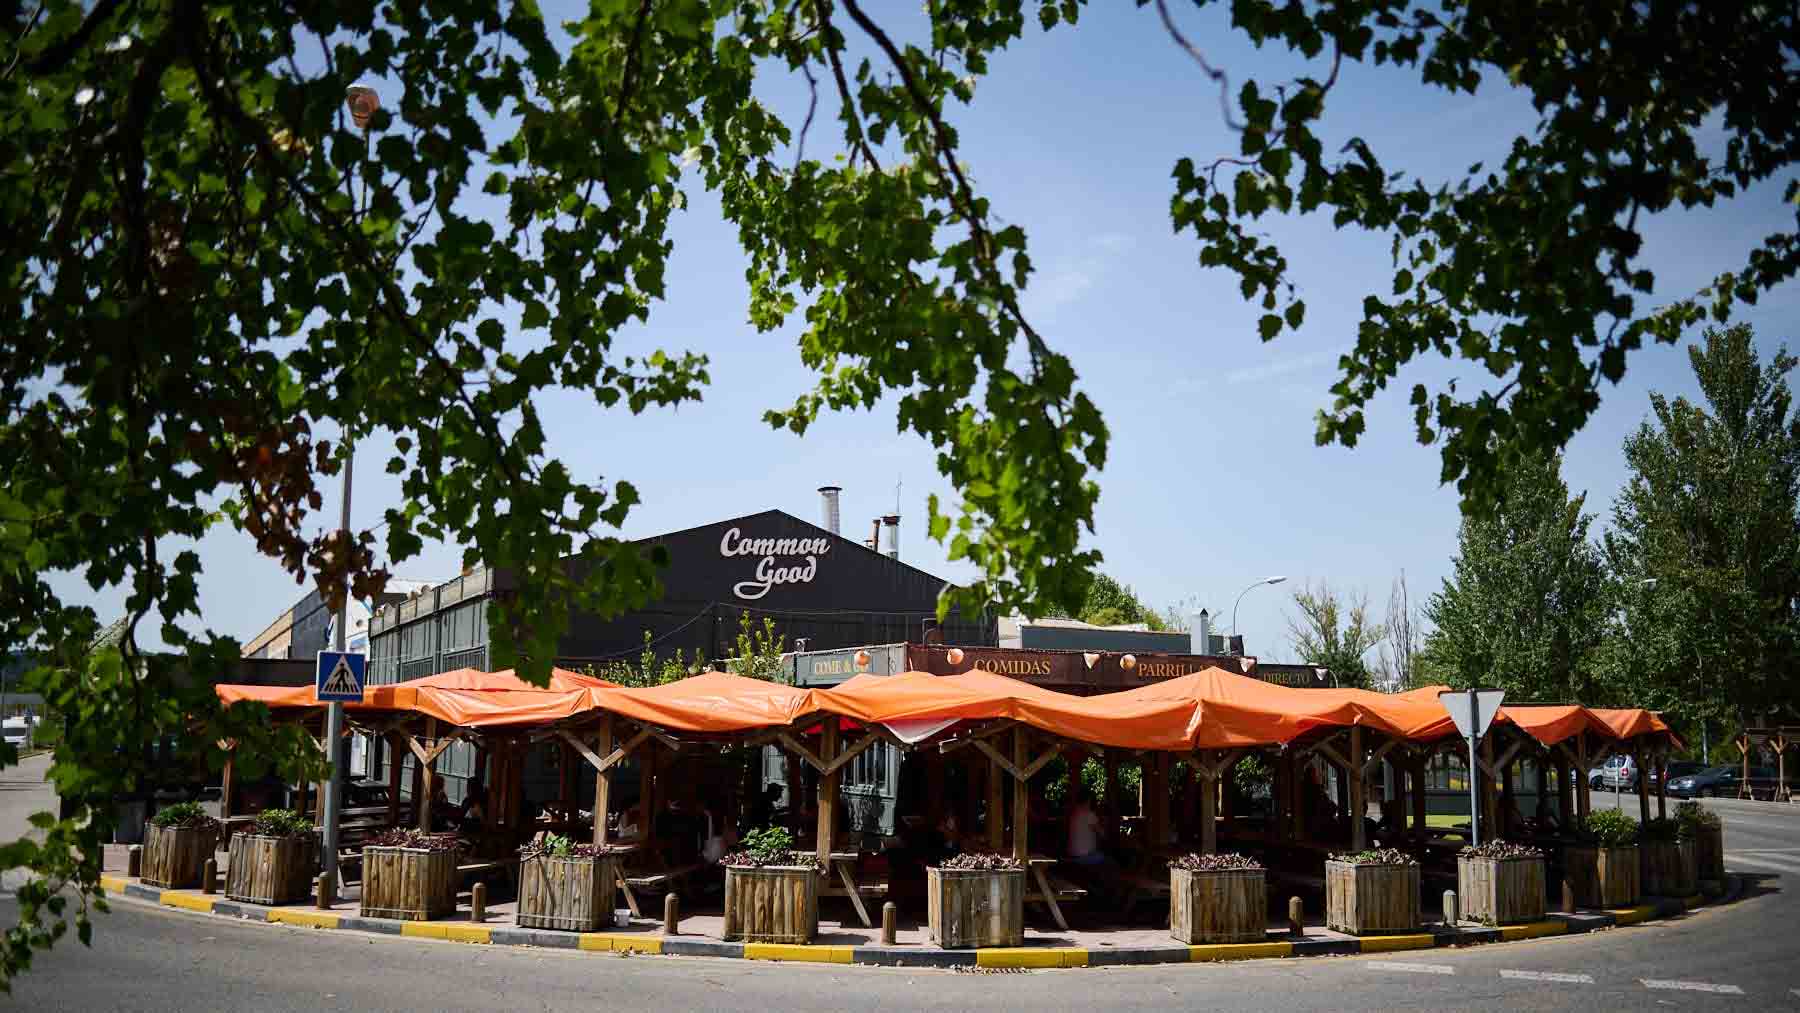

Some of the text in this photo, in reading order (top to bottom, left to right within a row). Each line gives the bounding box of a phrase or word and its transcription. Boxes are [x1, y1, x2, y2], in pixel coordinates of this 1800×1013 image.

[720, 527, 830, 557] Common
[733, 555, 817, 600] Good
[974, 659, 1051, 675] COMIDAS
[1263, 671, 1311, 686] DIRECTO
